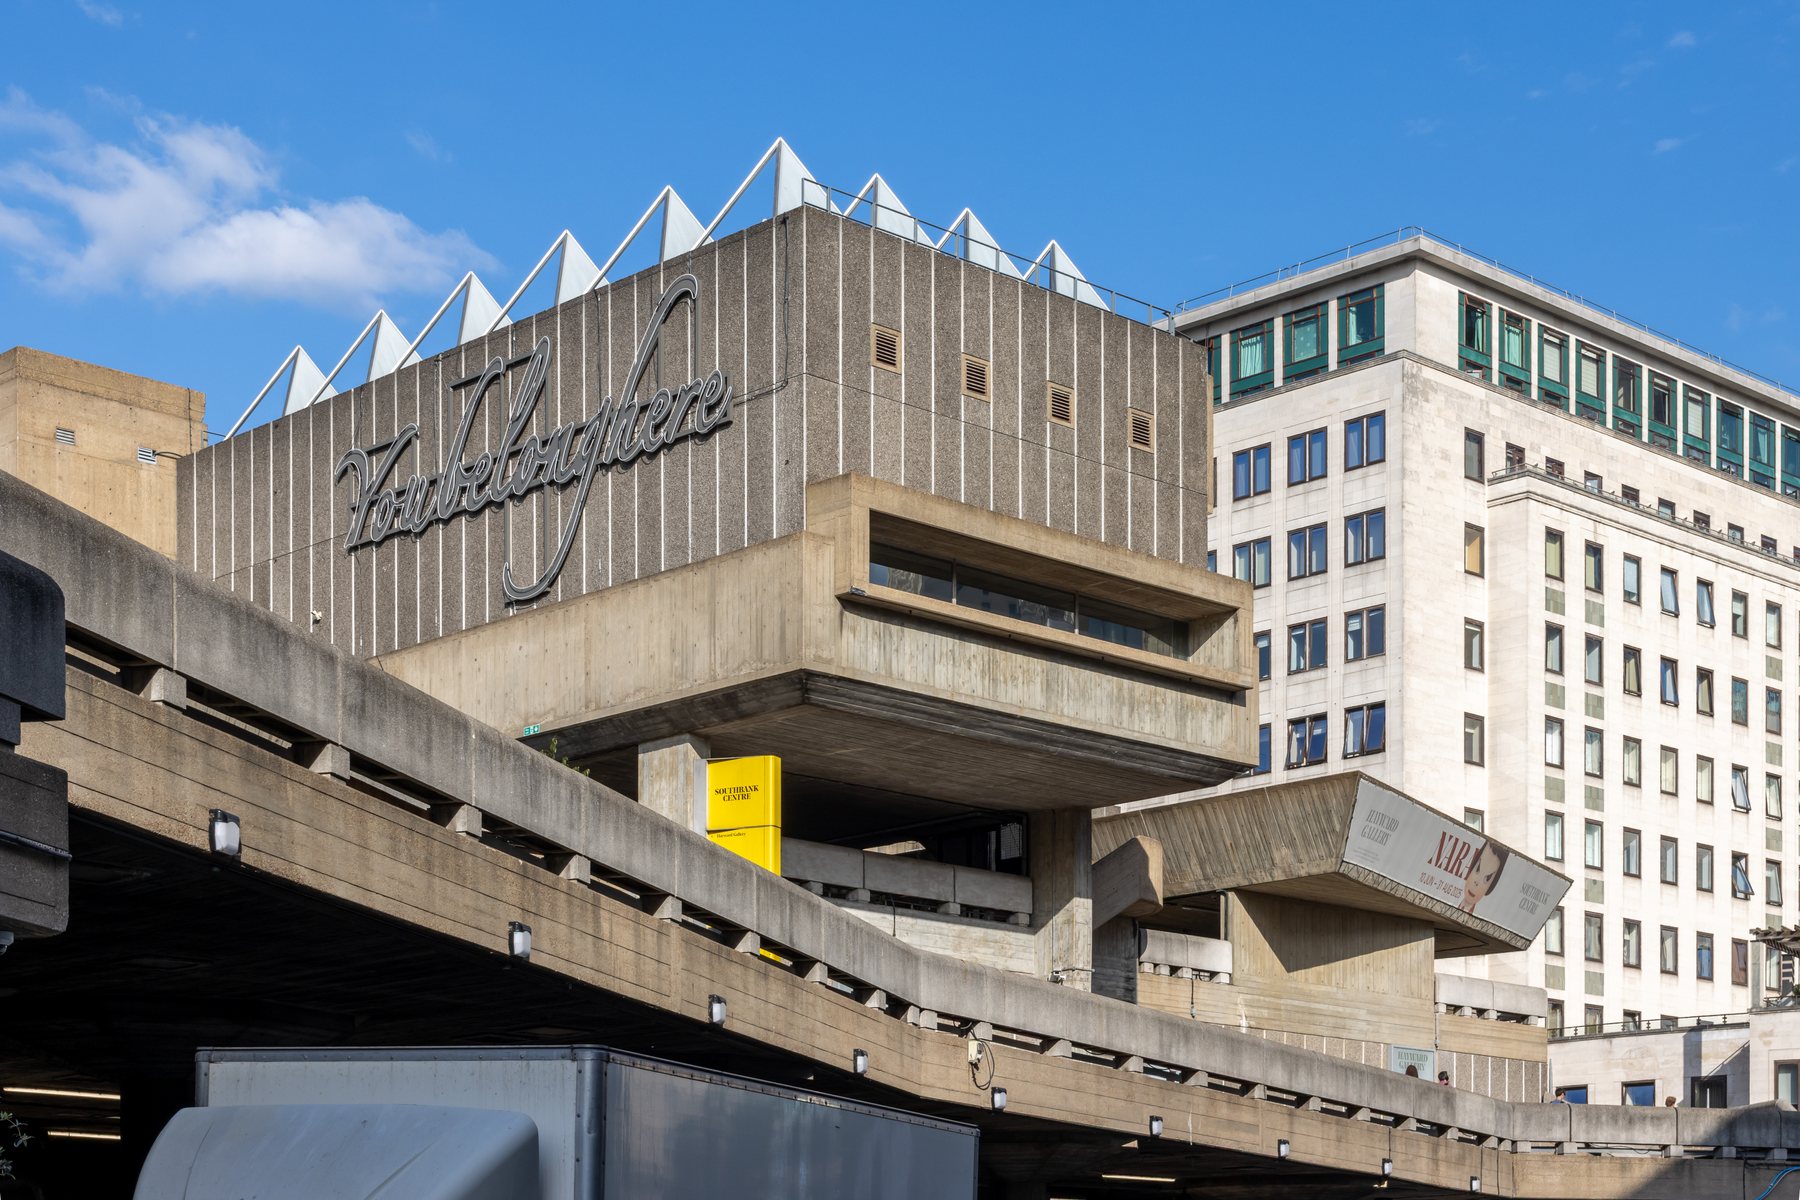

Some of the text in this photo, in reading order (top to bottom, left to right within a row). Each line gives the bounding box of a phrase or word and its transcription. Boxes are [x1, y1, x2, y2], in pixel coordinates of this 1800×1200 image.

[715, 785, 758, 795] SOUTHBANK
[723, 793, 751, 801] CENTRE
[1366, 809, 1400, 832] HAYWARD
[1361, 824, 1392, 846] GALLERY
[1427, 831, 1481, 881] NARA
[1442, 882, 1454, 895] AUG
[1450, 886, 1463, 899] 2025
[1397, 1050, 1428, 1062] HAYWARD
